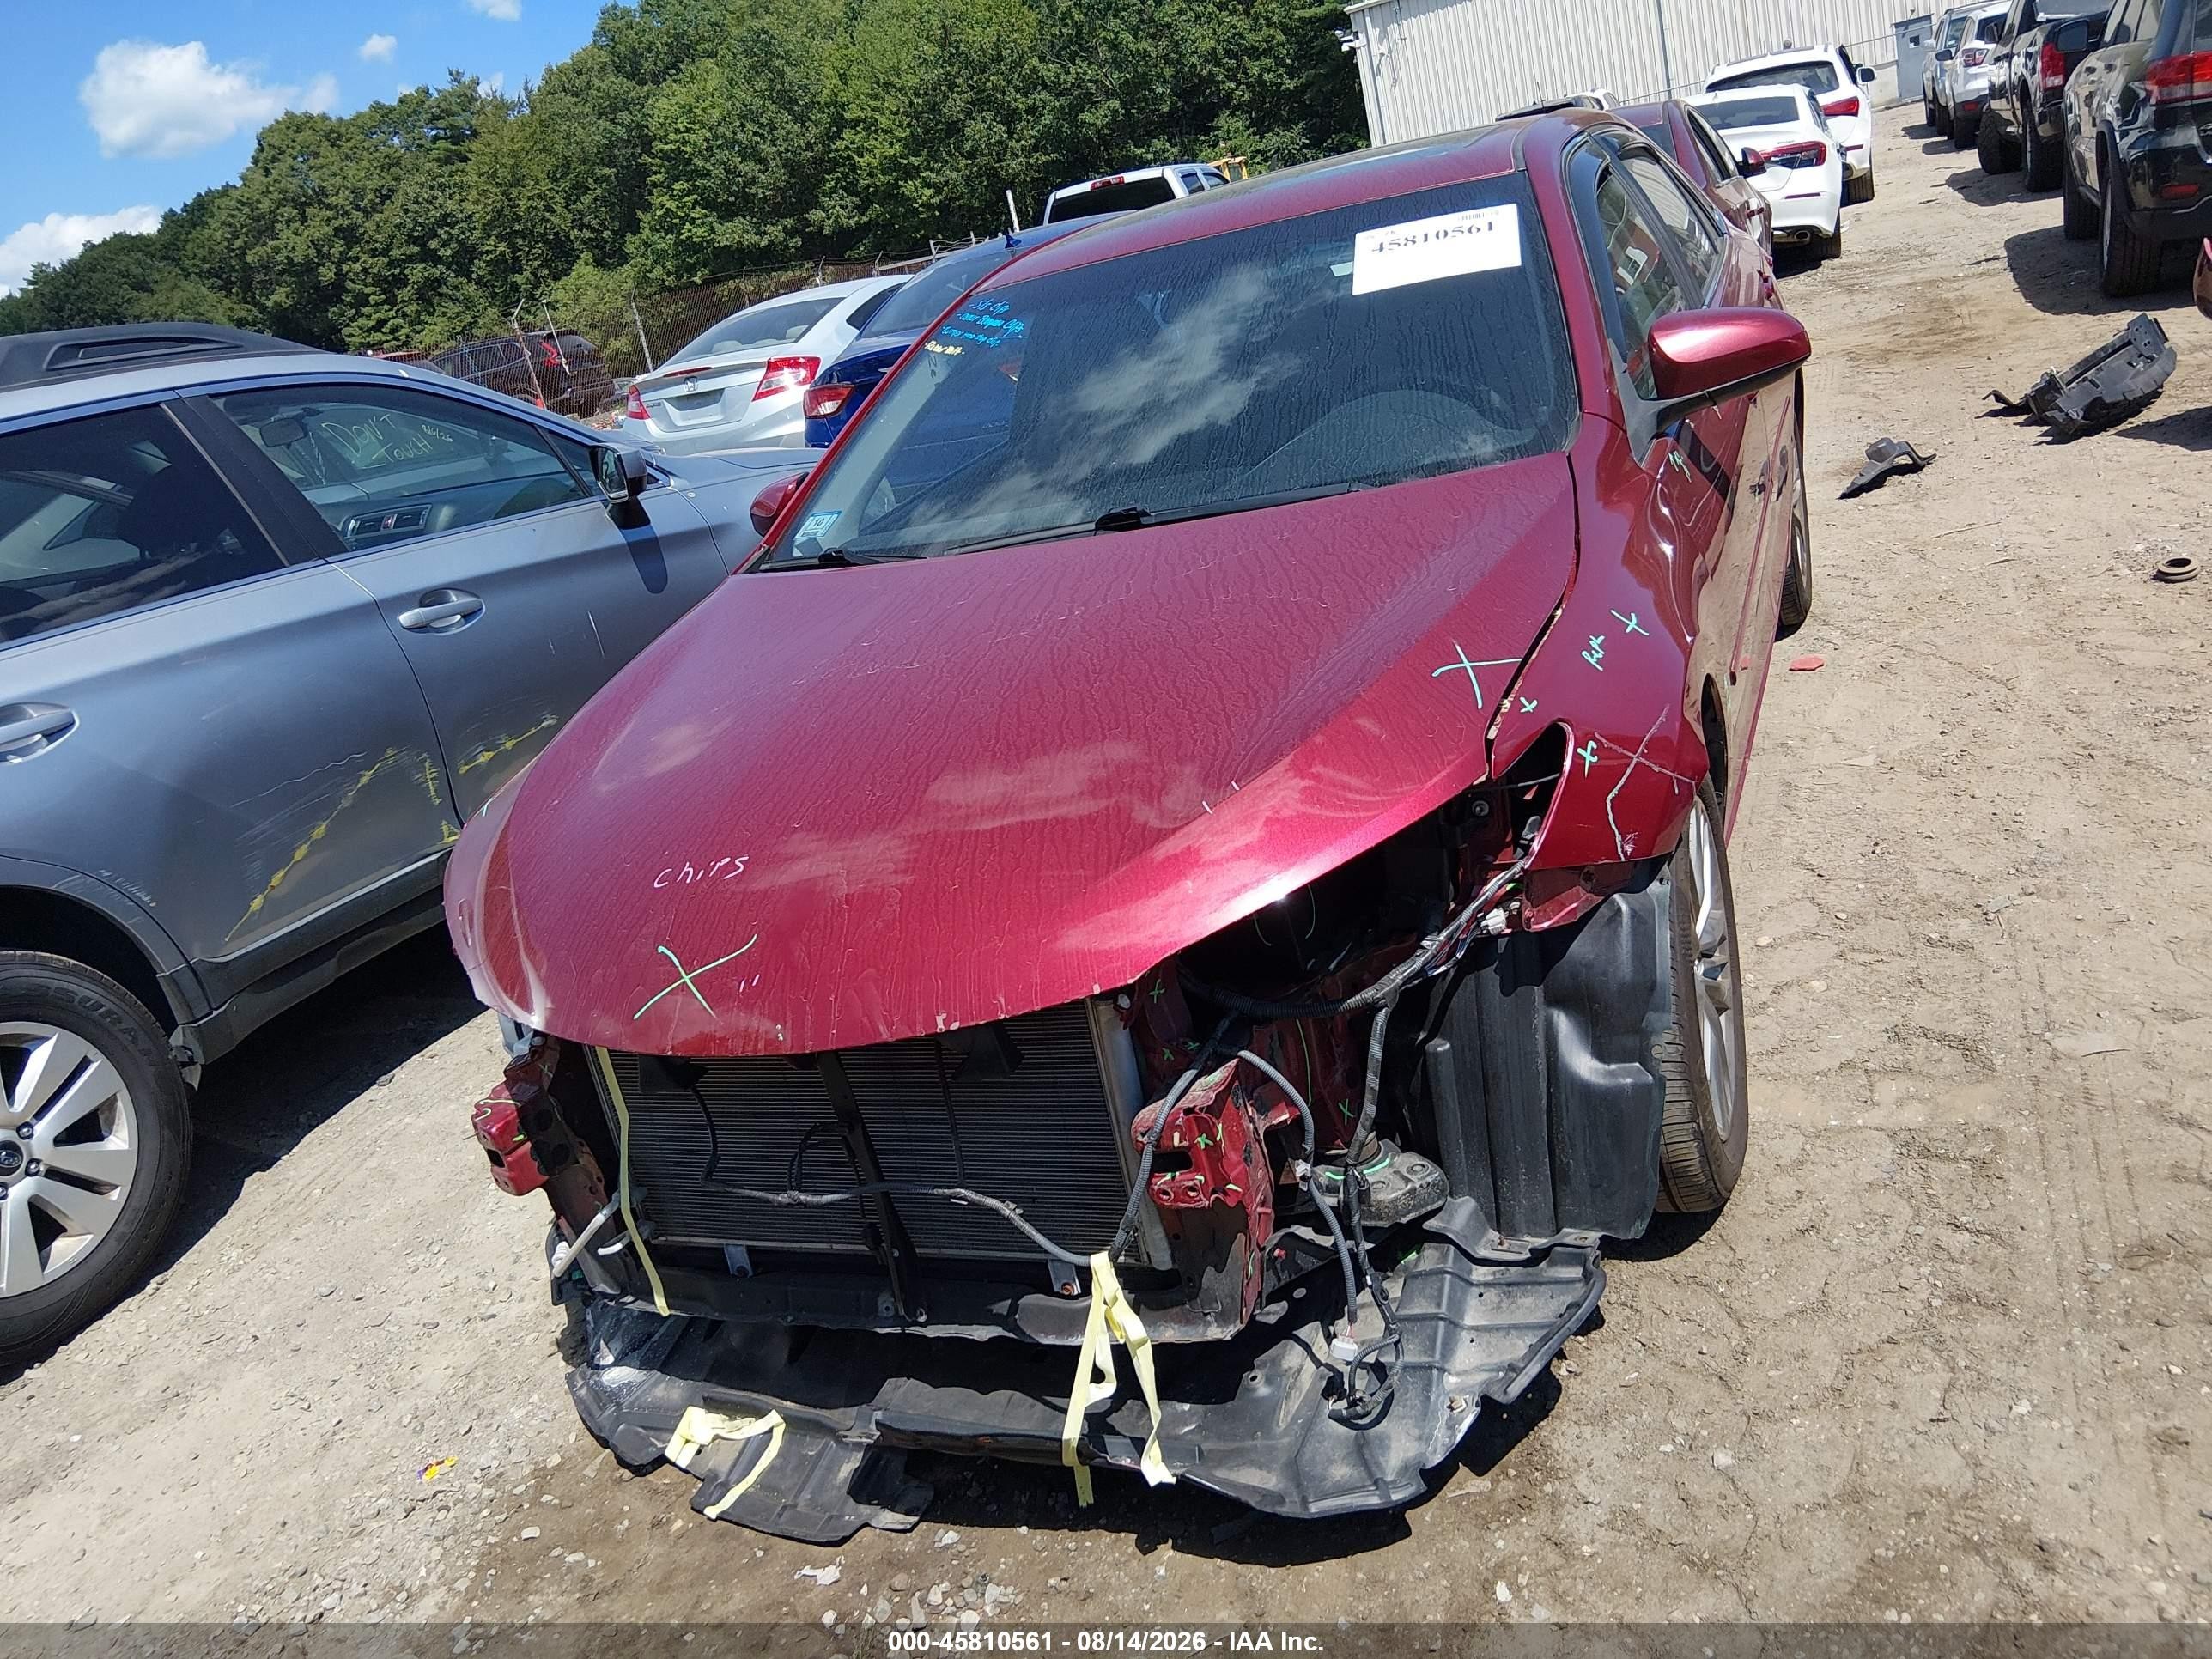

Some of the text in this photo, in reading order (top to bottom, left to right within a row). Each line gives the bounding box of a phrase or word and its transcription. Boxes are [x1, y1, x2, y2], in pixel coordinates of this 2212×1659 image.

[1371, 221, 1494, 252] 45810561
[321, 413, 397, 458] DON'T
[372, 433, 434, 463] TOUCH
